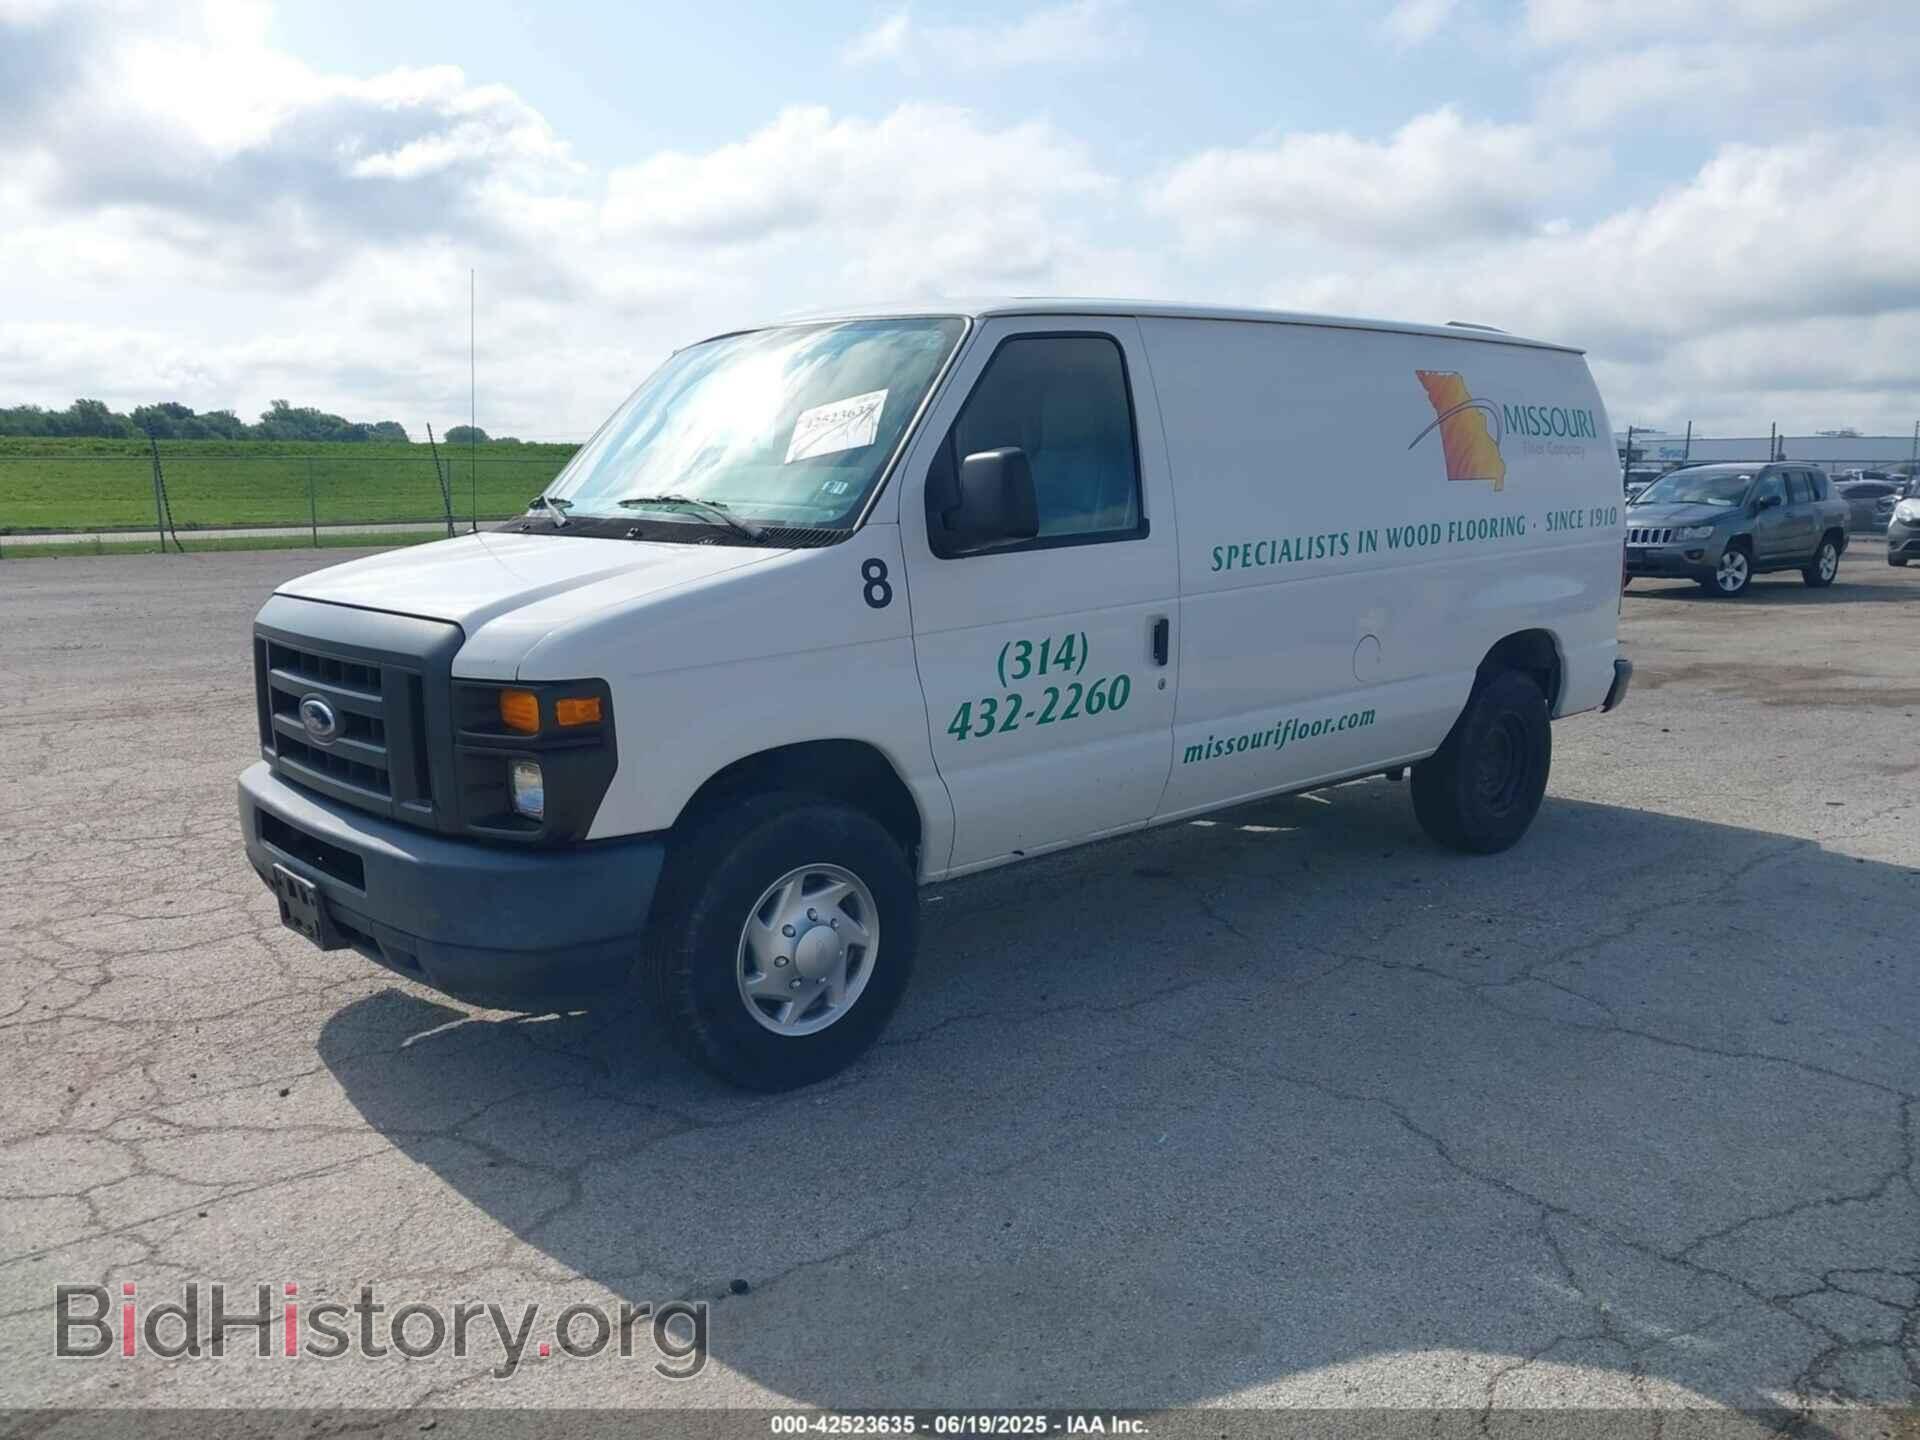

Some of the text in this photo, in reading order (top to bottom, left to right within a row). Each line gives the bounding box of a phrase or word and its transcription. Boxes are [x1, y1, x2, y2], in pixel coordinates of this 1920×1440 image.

[1503, 404, 1597, 438] MISSOURI
[1211, 532, 1350, 573] SPECIALISTS
[1357, 529, 1378, 554] IN
[1387, 523, 1441, 549] WOOD
[1447, 515, 1526, 544] FLOORING
[1545, 509, 1584, 532] SINCE
[1589, 505, 1618, 528] 1910
[861, 558, 893, 609] 8
[997, 632, 1089, 687] (314)
[947, 674, 1131, 742] 432-2260
[1183, 709, 1377, 764] missourifloor.com
